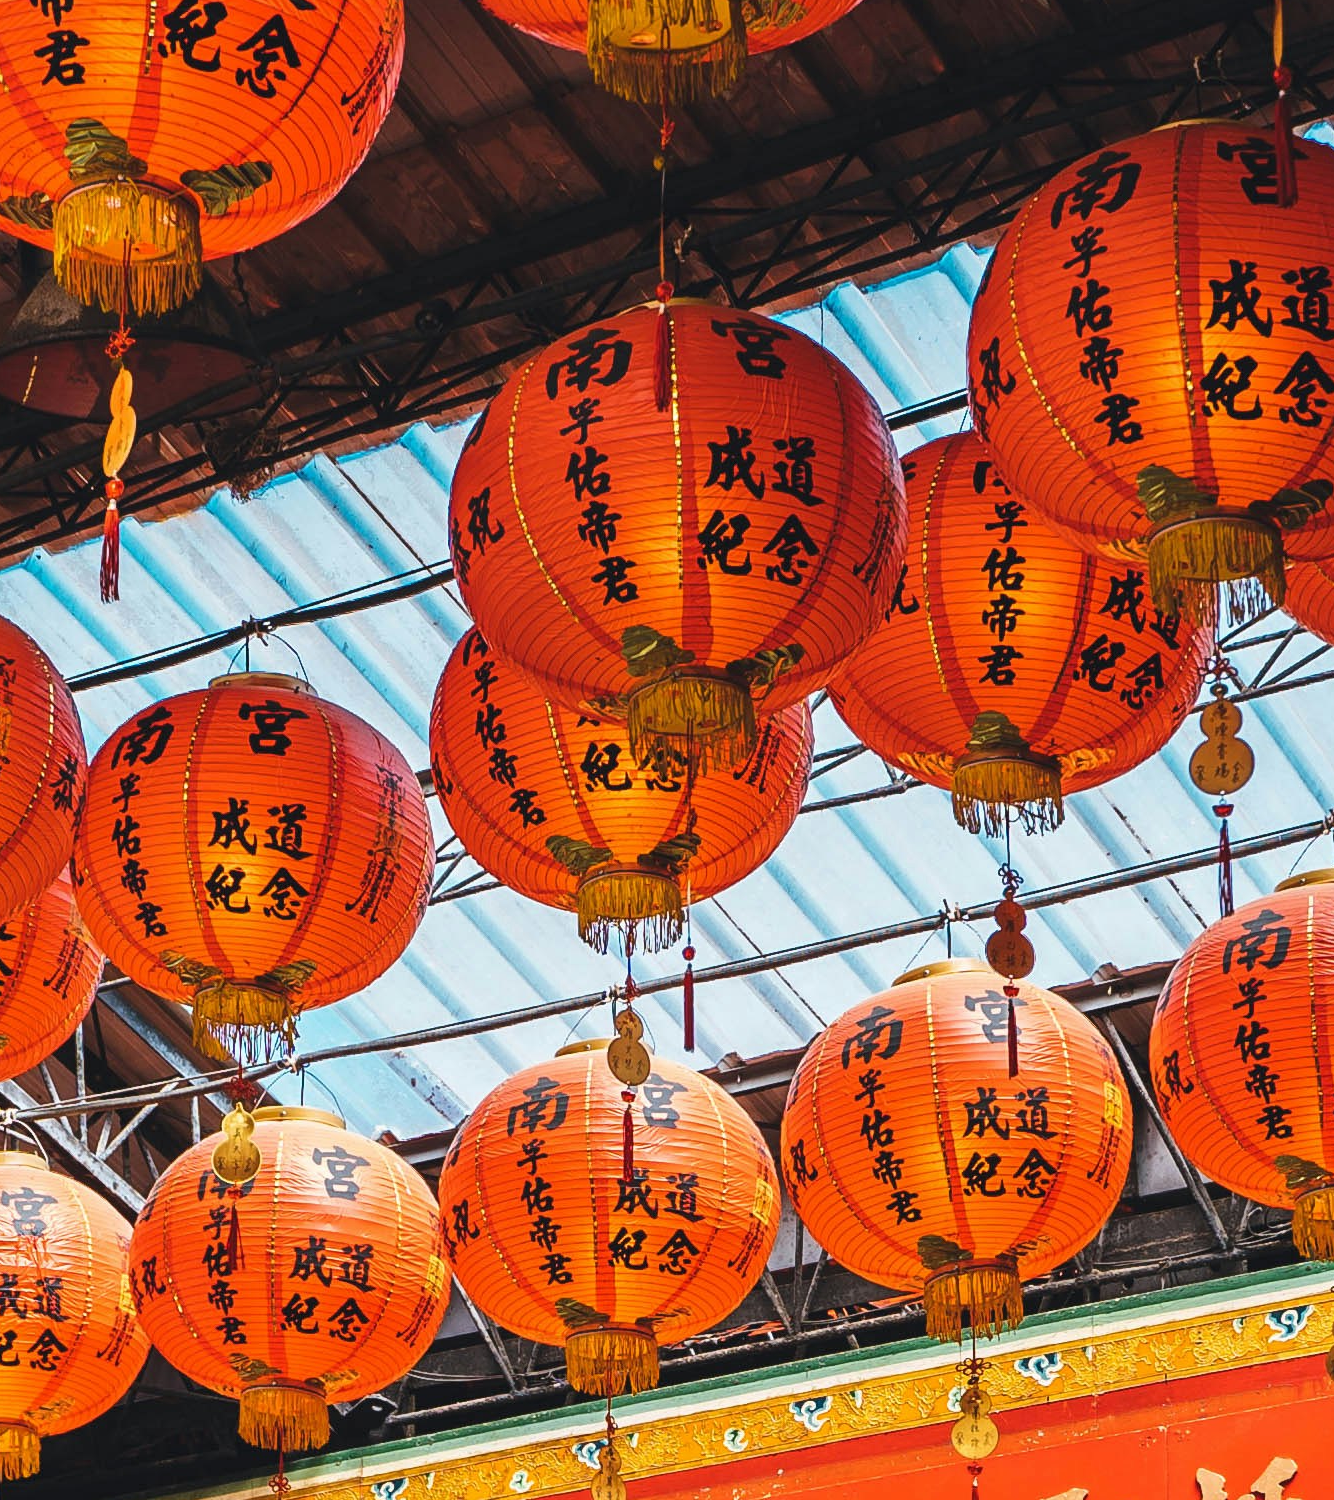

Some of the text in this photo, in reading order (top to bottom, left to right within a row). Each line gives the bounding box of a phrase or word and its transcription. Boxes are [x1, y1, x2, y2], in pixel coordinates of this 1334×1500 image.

[1063, 225, 1143, 446] 孚佑帝君
[560, 399, 640, 605] 孚佑帝君
[708, 426, 824, 506] 成道
[697, 510, 819, 585] 紀念
[978, 501, 1028, 686] 孚佑帝君
[112, 773, 168, 938] 孚佑帝君
[208, 798, 313, 861] 成道
[204, 864, 309, 920] 紀念
[1233, 977, 1294, 1140] 孚佑帝君
[854, 1074, 922, 1225] 孚佑帝君
[963, 1087, 1056, 1141] 成道
[517, 1139, 573, 1286] 孚佑帝君
[963, 1149, 1059, 1199] 紀念
[288, 1236, 376, 1293] 成道
[609, 1227, 701, 1275] 紀念
[279, 1298, 368, 1341] 紀念
